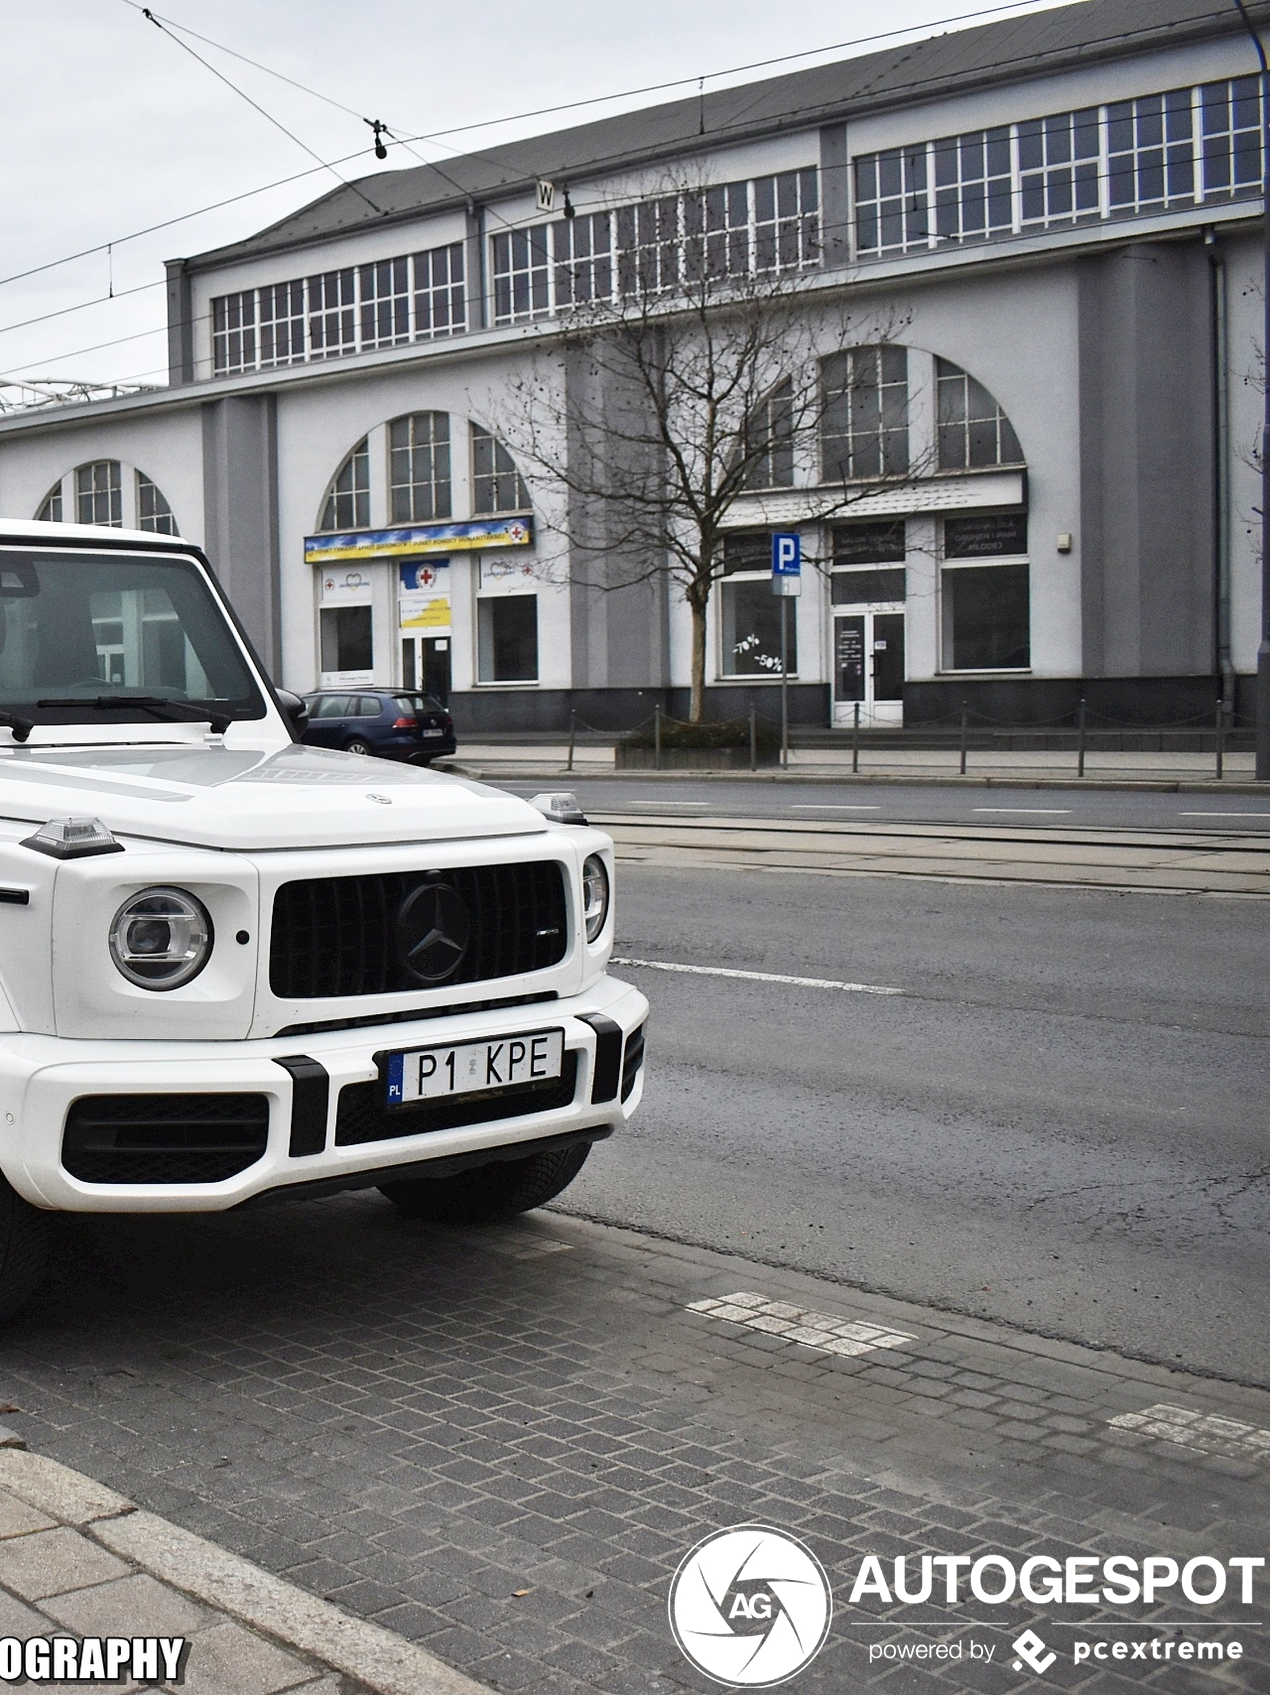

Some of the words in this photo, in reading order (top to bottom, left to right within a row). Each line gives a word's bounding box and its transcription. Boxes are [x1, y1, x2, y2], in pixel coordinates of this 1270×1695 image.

[540, 183, 553, 206] W
[778, 537, 796, 570] P
[732, 634, 760, 654] -70%
[754, 654, 783, 672] -50%
[418, 1051, 456, 1096] P1
[486, 1037, 549, 1085] KPE
[389, 1085, 401, 1096] PL
